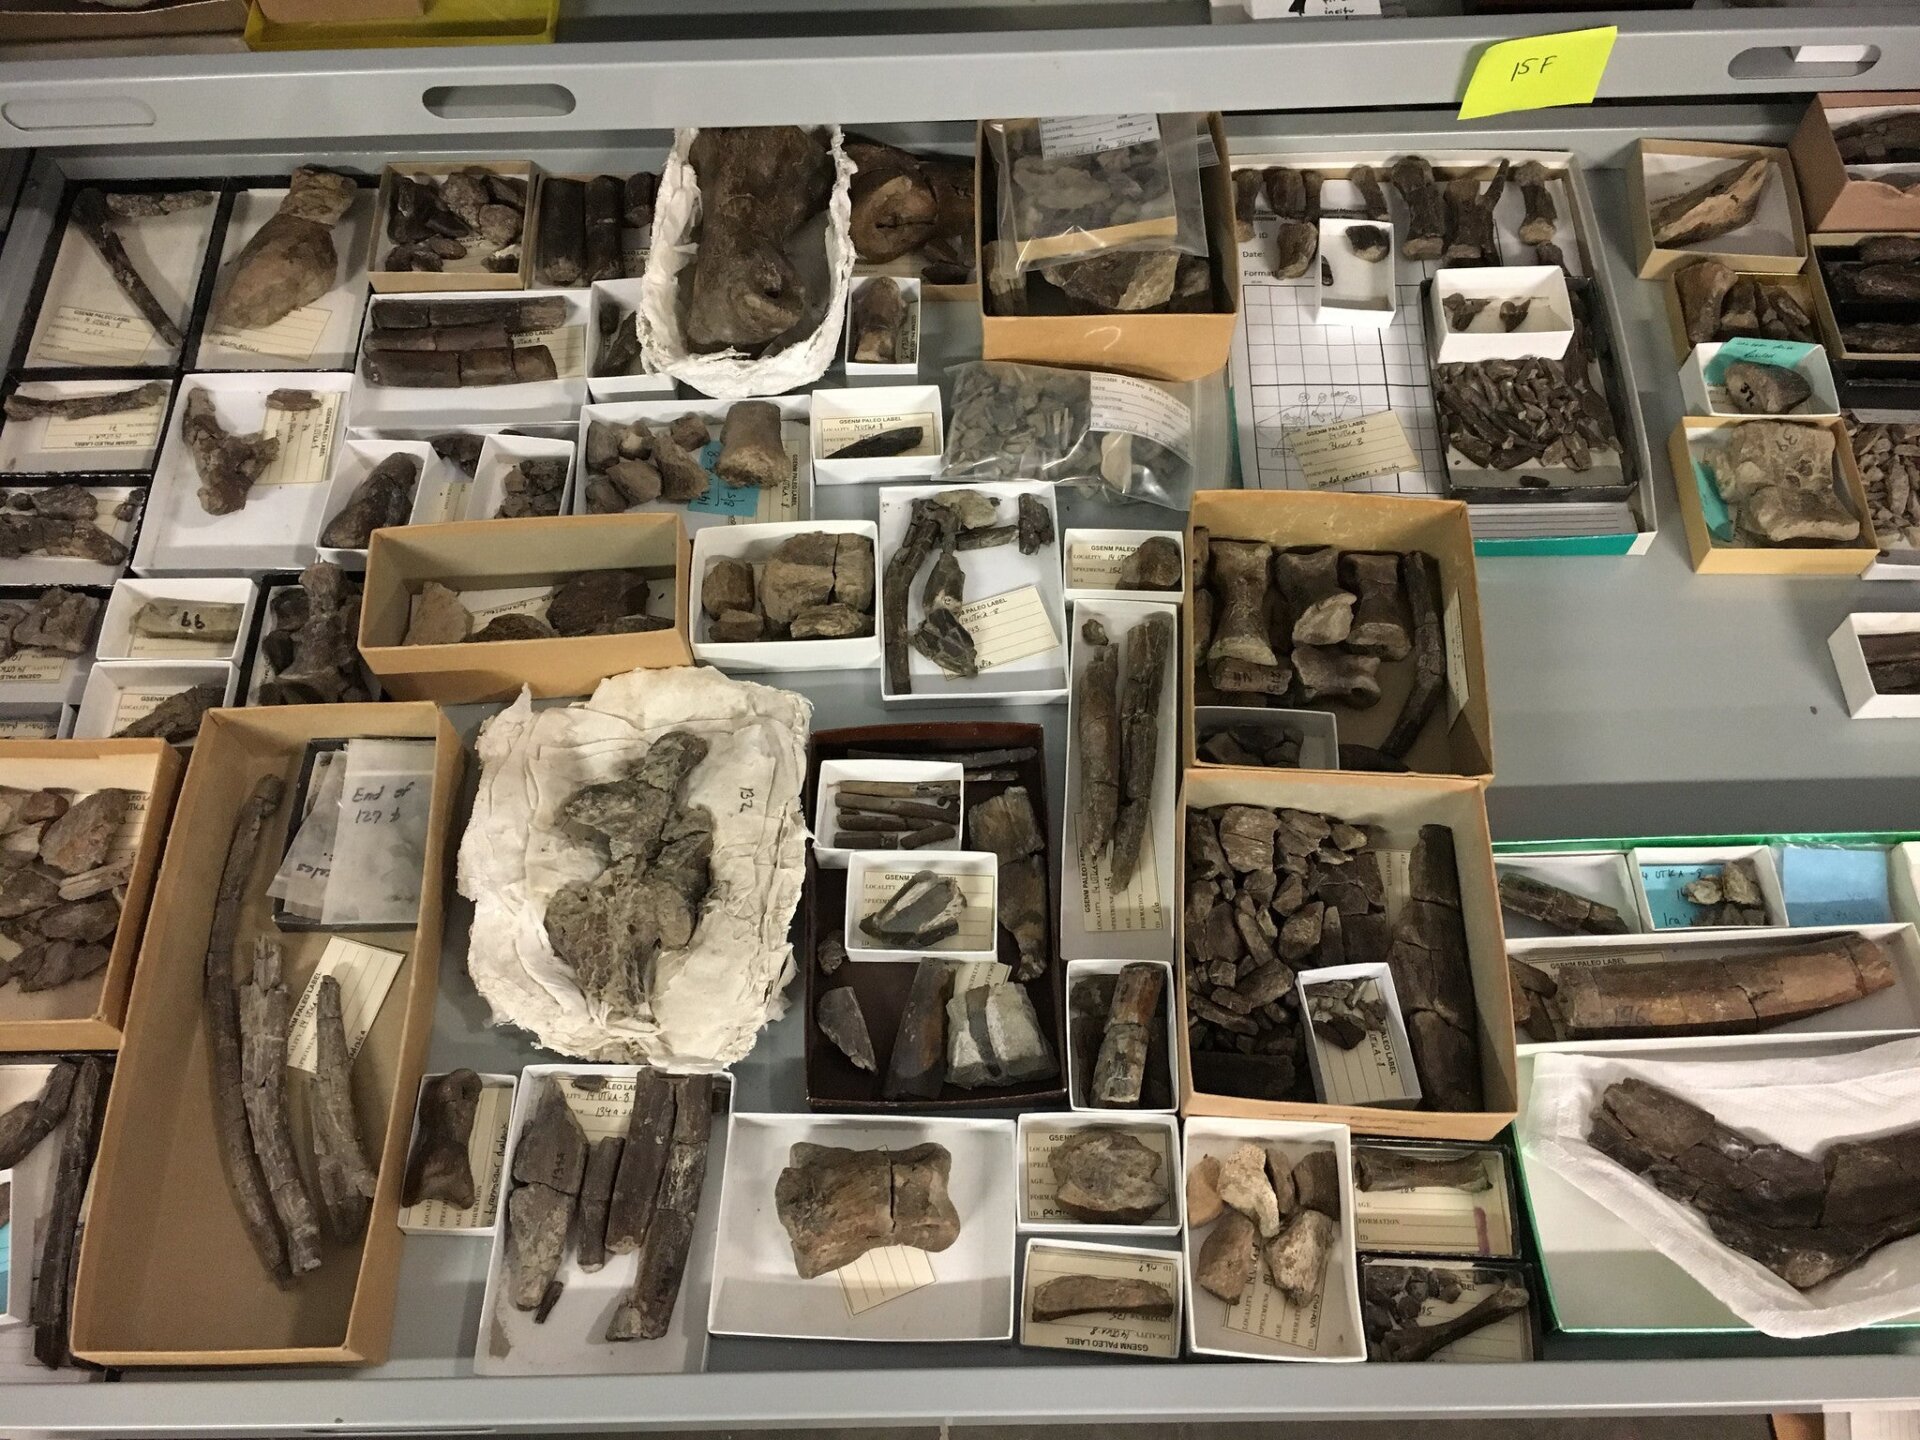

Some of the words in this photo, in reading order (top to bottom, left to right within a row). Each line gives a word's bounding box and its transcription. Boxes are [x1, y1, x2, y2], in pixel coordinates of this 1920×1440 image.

[1510, 57, 1540, 82] 15
[1540, 55, 1558, 74] F
[1242, 250, 1266, 258] Date:
[1243, 270, 1276, 278] Format
[1114, 545, 1137, 553] PALEO
[964, 603, 987, 615] PALEO
[986, 597, 1008, 608] LABEL
[352, 784, 386, 803] End
[393, 781, 416, 799] of
[1081, 866, 1089, 888] PALEO
[1083, 889, 1091, 913] GSENM
[1385, 1051, 1397, 1077] LABEL
[1358, 1217, 1400, 1225] FORMATION
[1064, 1337, 1091, 1346] LABEL
[1092, 1339, 1119, 1349] PALEO
[1119, 1342, 1149, 1352] GSENM
